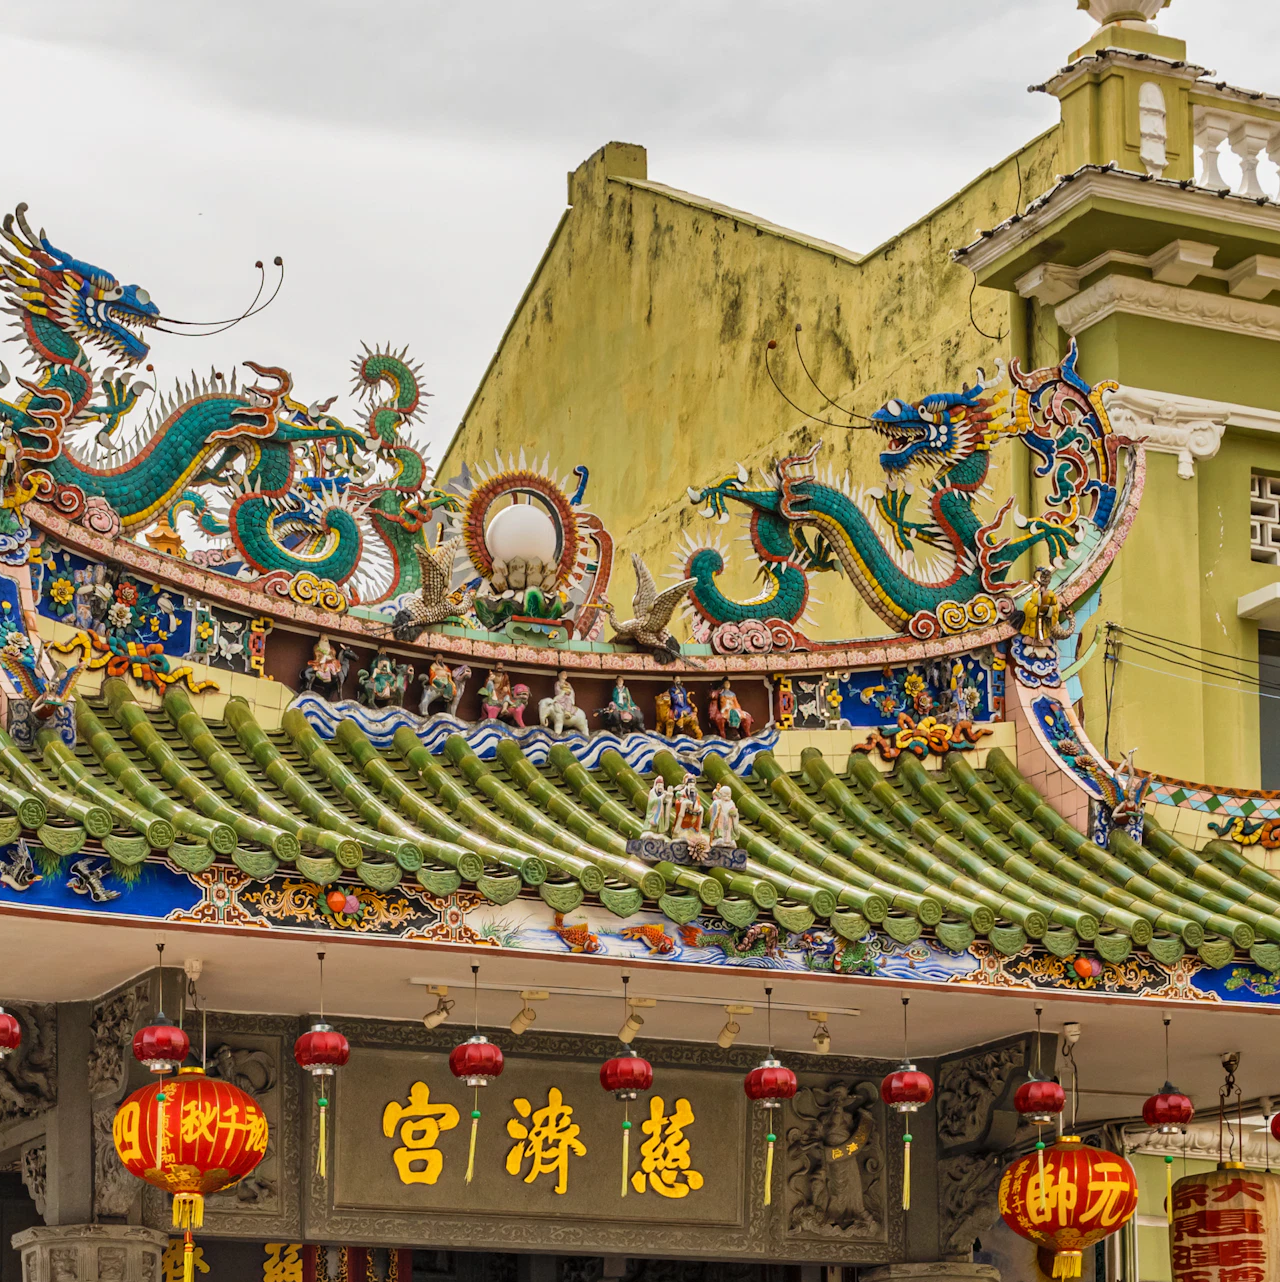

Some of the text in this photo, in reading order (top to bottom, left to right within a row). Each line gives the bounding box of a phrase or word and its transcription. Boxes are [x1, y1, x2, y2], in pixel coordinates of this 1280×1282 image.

[382, 1081, 705, 1199] 慈濟宮
[1025, 1162, 1130, 1227] 元帥
